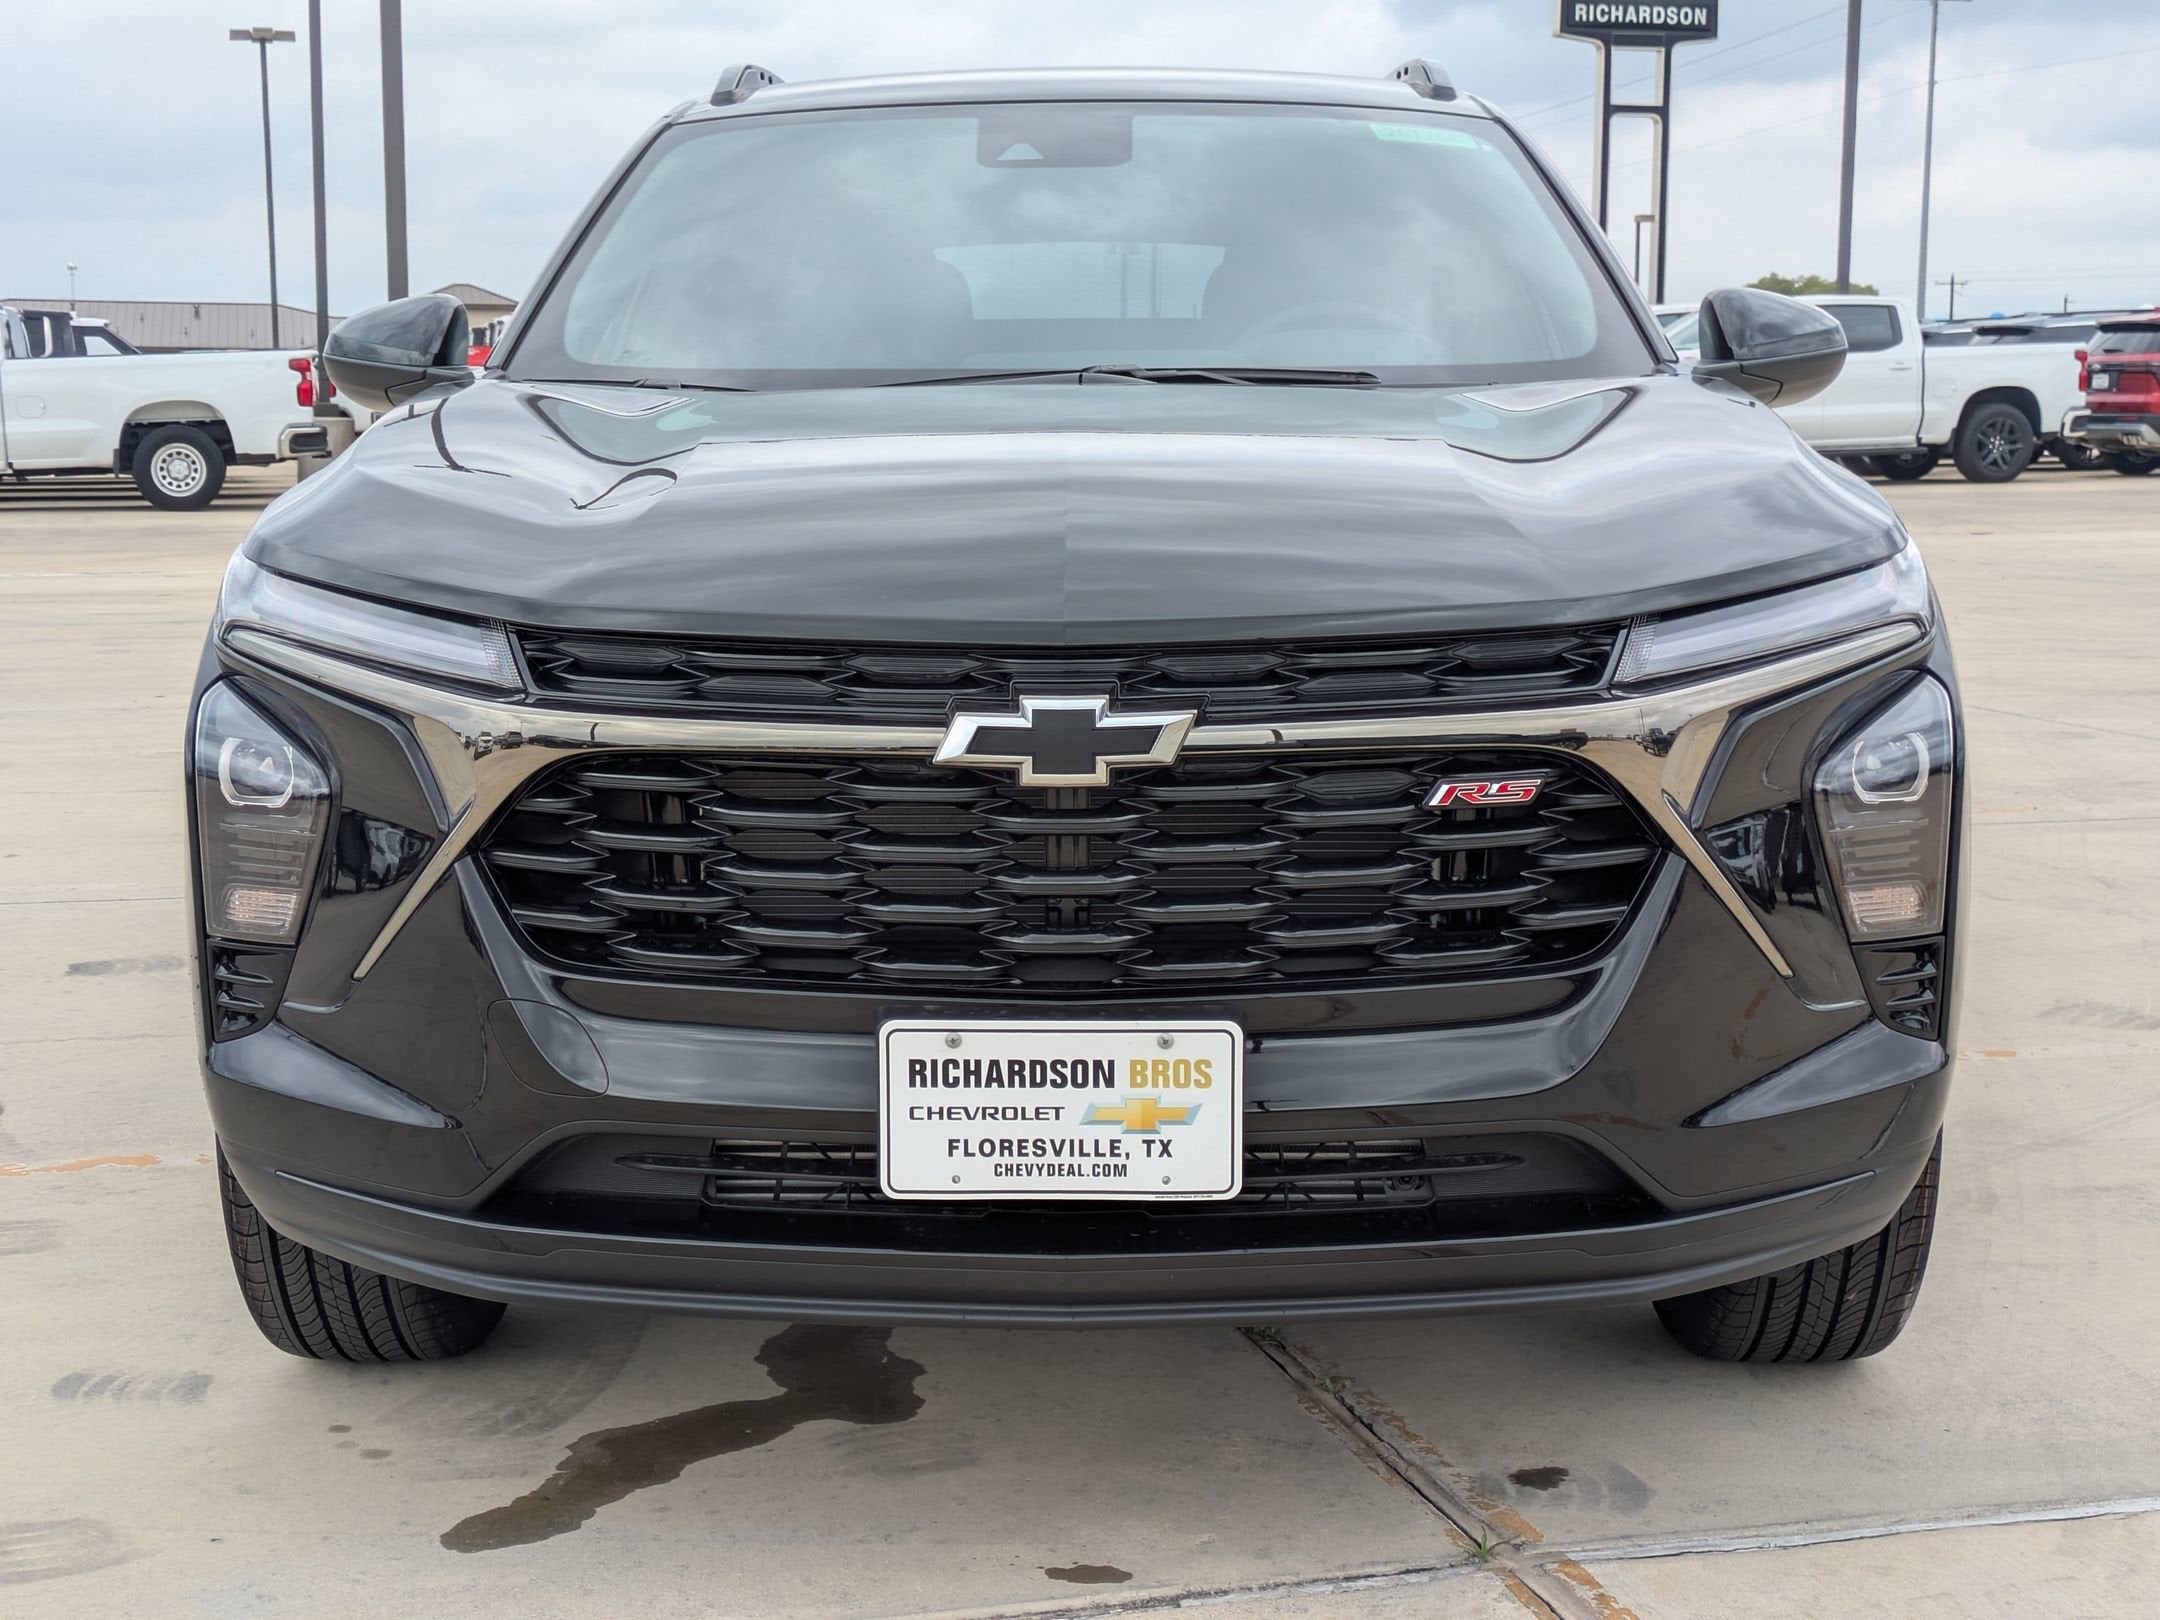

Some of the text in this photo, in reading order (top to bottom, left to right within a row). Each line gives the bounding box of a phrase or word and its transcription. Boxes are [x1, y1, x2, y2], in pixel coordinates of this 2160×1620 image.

[1574, 3, 1707, 26] RICHARDSON
[1428, 779, 1541, 806] RS
[908, 1058, 1212, 1089] RICHARDSON BROS
[909, 1106, 1065, 1121] CHEVROLET
[948, 1138, 1173, 1160] FLORESVILLE, TX
[994, 1163, 1128, 1178] CHEVYDEAL.COM
